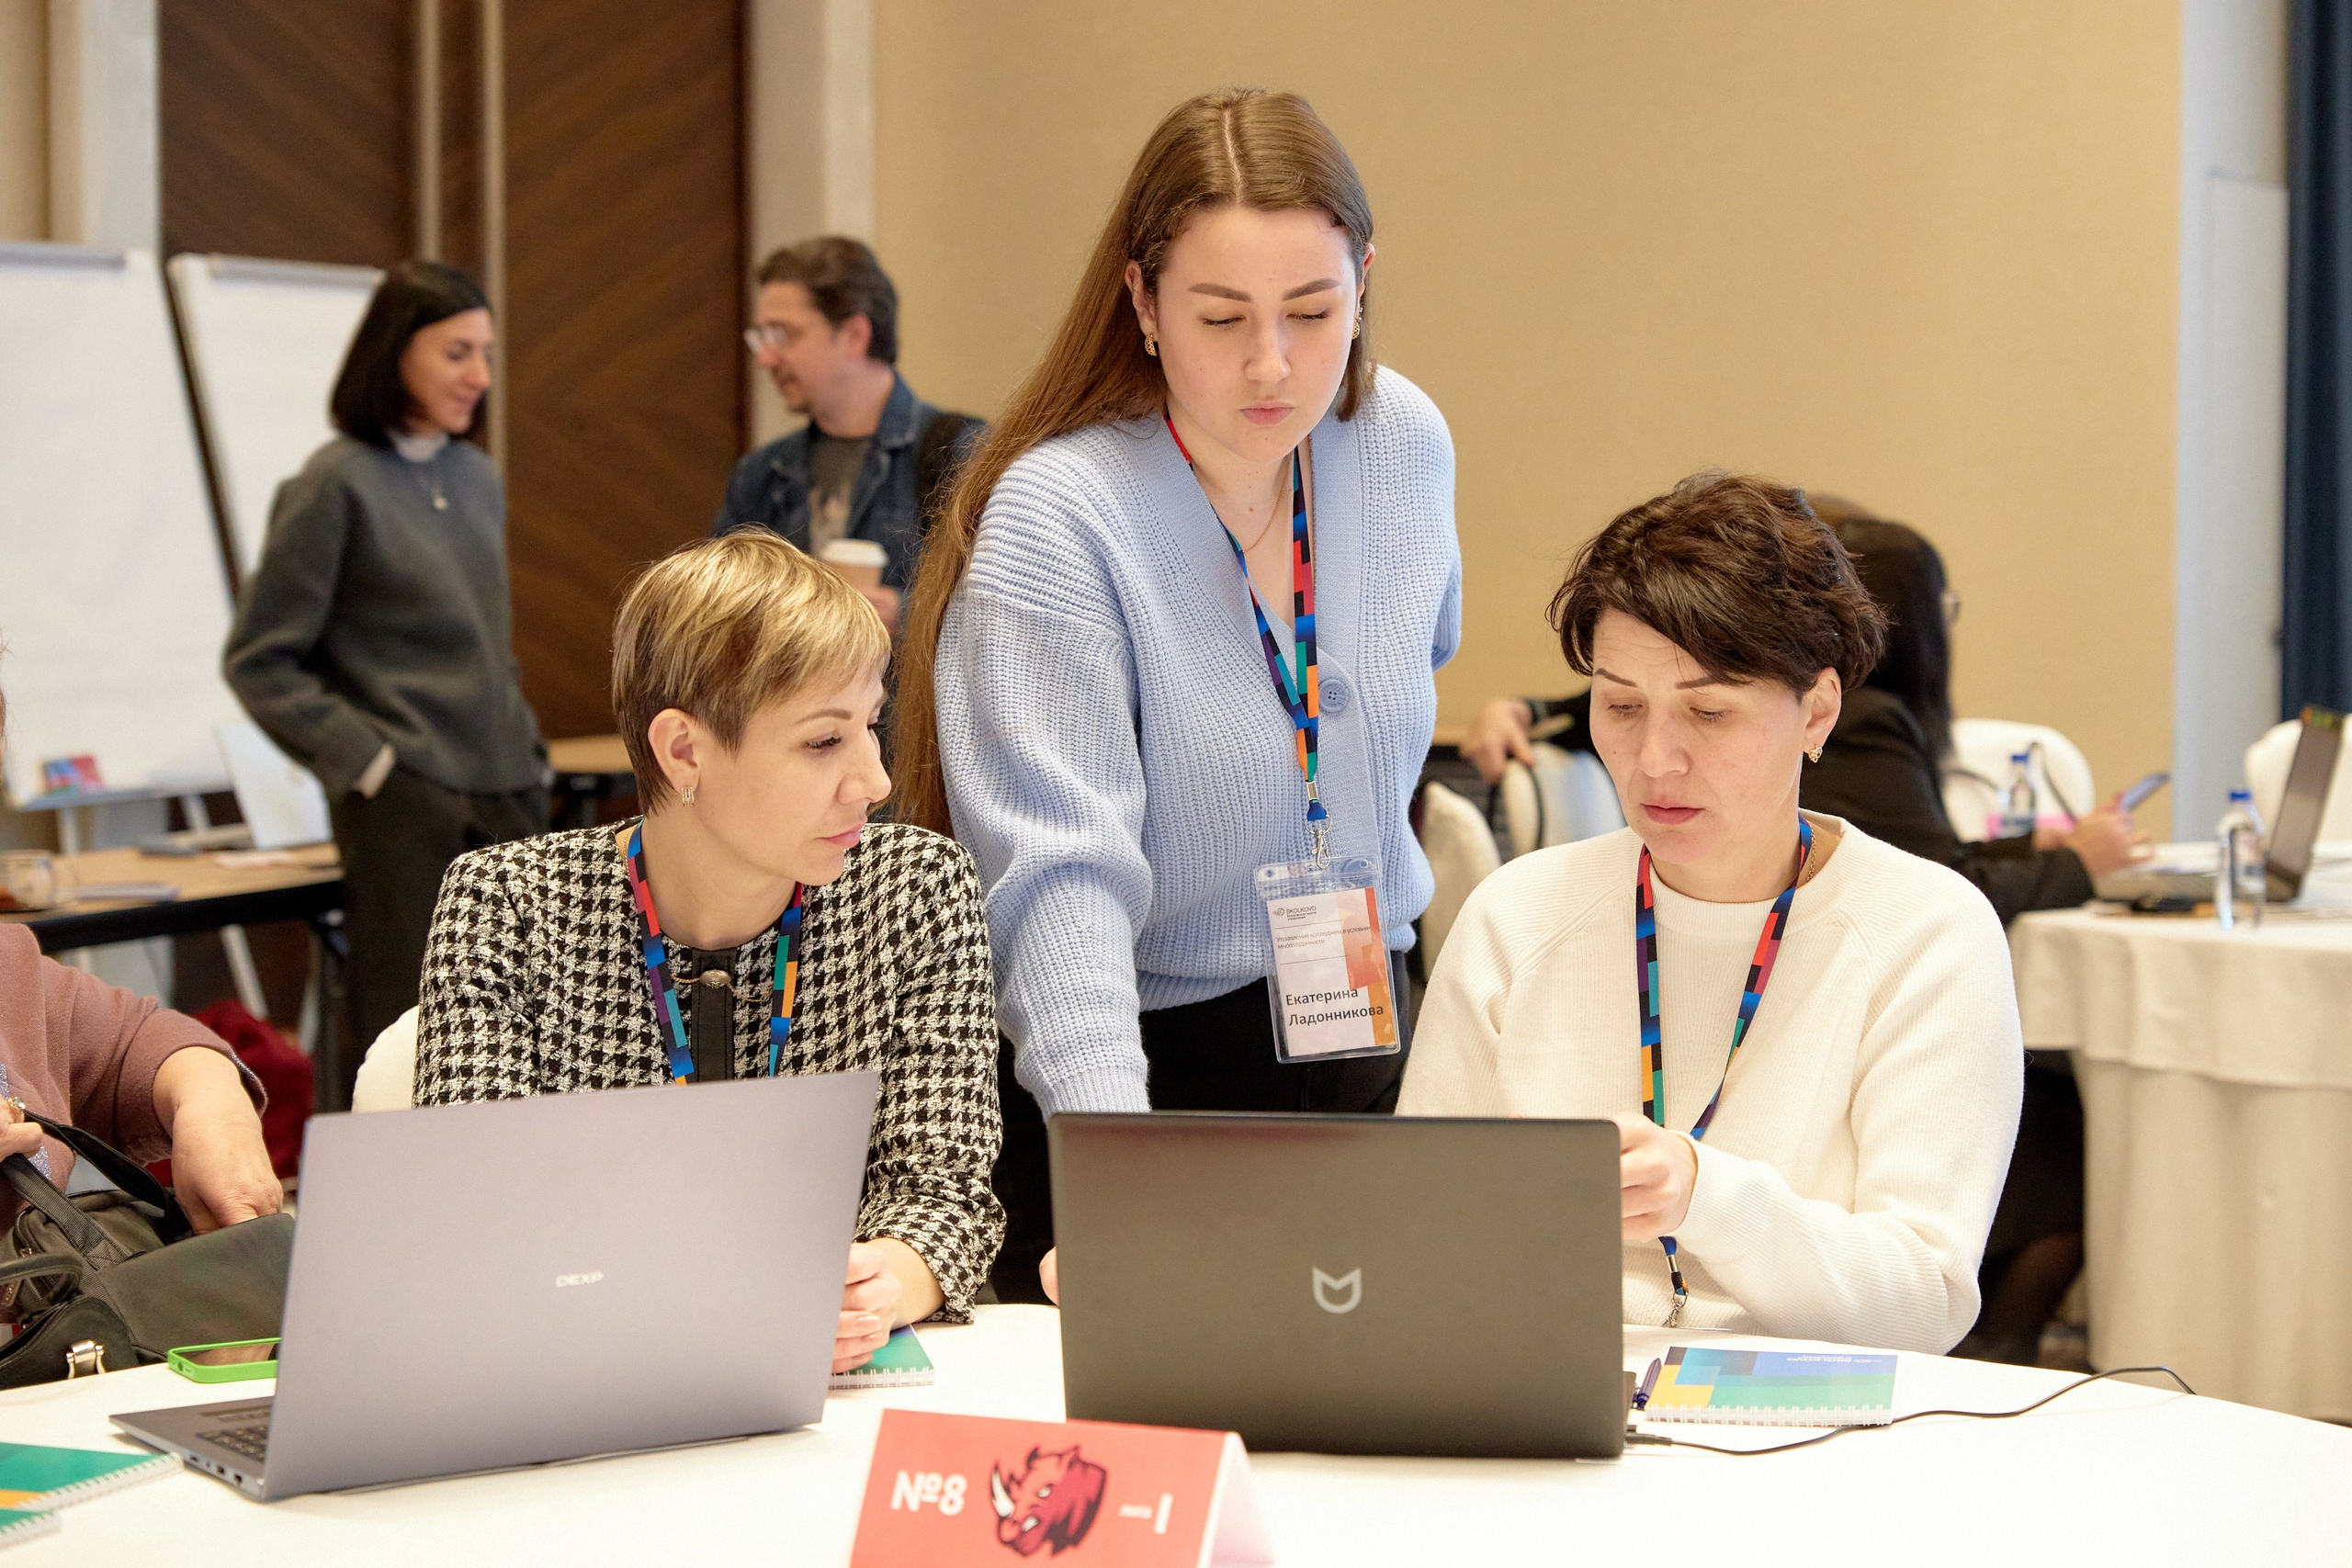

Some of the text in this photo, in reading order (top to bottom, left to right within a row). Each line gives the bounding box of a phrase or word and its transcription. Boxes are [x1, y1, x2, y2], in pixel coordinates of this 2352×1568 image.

[1286, 906, 1317, 914] SKOLKOVO
[1276, 933, 1310, 942] Управление
[1278, 939, 1326, 950] многозадачности
[1285, 988, 1359, 1007] Екатерина
[1289, 1005, 1384, 1027] Ладонникова
[556, 1271, 604, 1288] DEXP
[890, 1469, 968, 1517] №8
